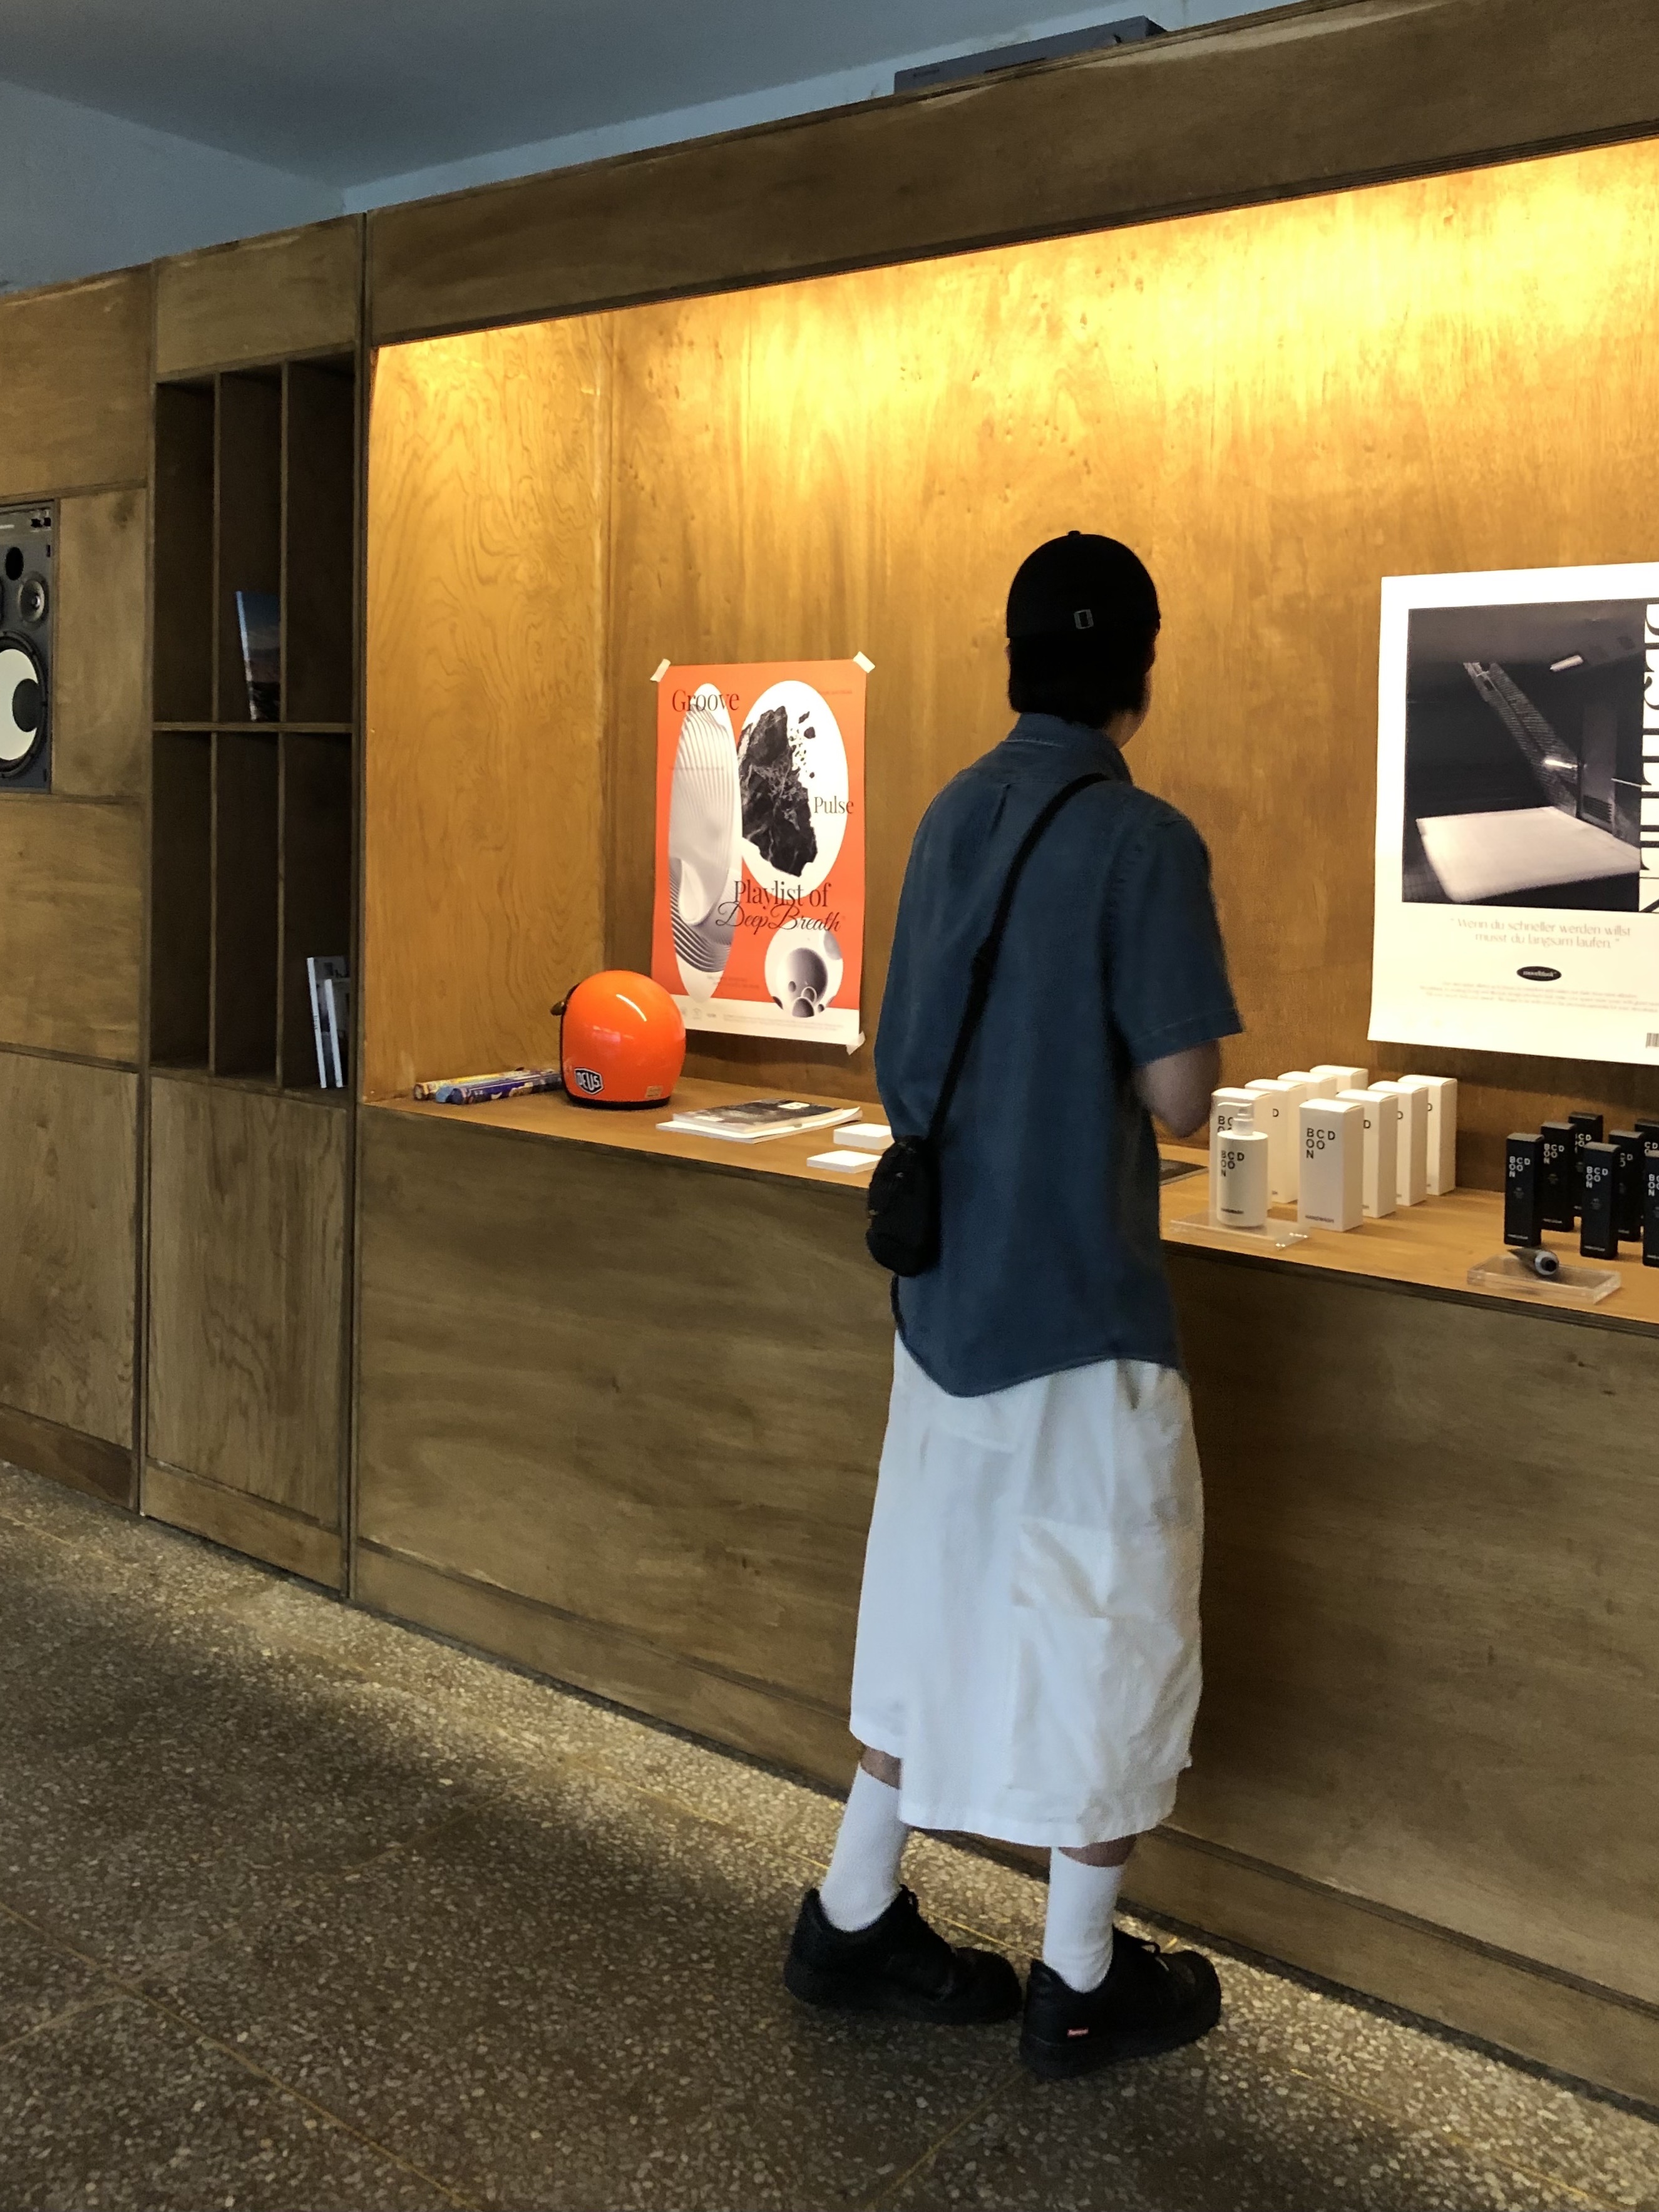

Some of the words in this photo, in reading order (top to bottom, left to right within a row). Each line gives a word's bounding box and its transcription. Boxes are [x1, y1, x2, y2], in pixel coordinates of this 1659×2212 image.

[672, 689, 740, 712] Groove
[814, 795, 854, 814] Pulse
[734, 879, 804, 910] Playlist
[809, 882, 832, 907] of
[715, 901, 769, 935] Deep
[768, 903, 841, 932] Breath
[1491, 918, 1505, 930] du
[1507, 920, 1555, 932] schneller
[1559, 923, 1601, 935] werden
[1511, 932, 1525, 944] du
[1528, 933, 1573, 948] langsam
[576, 1071, 601, 1091] DEUS
